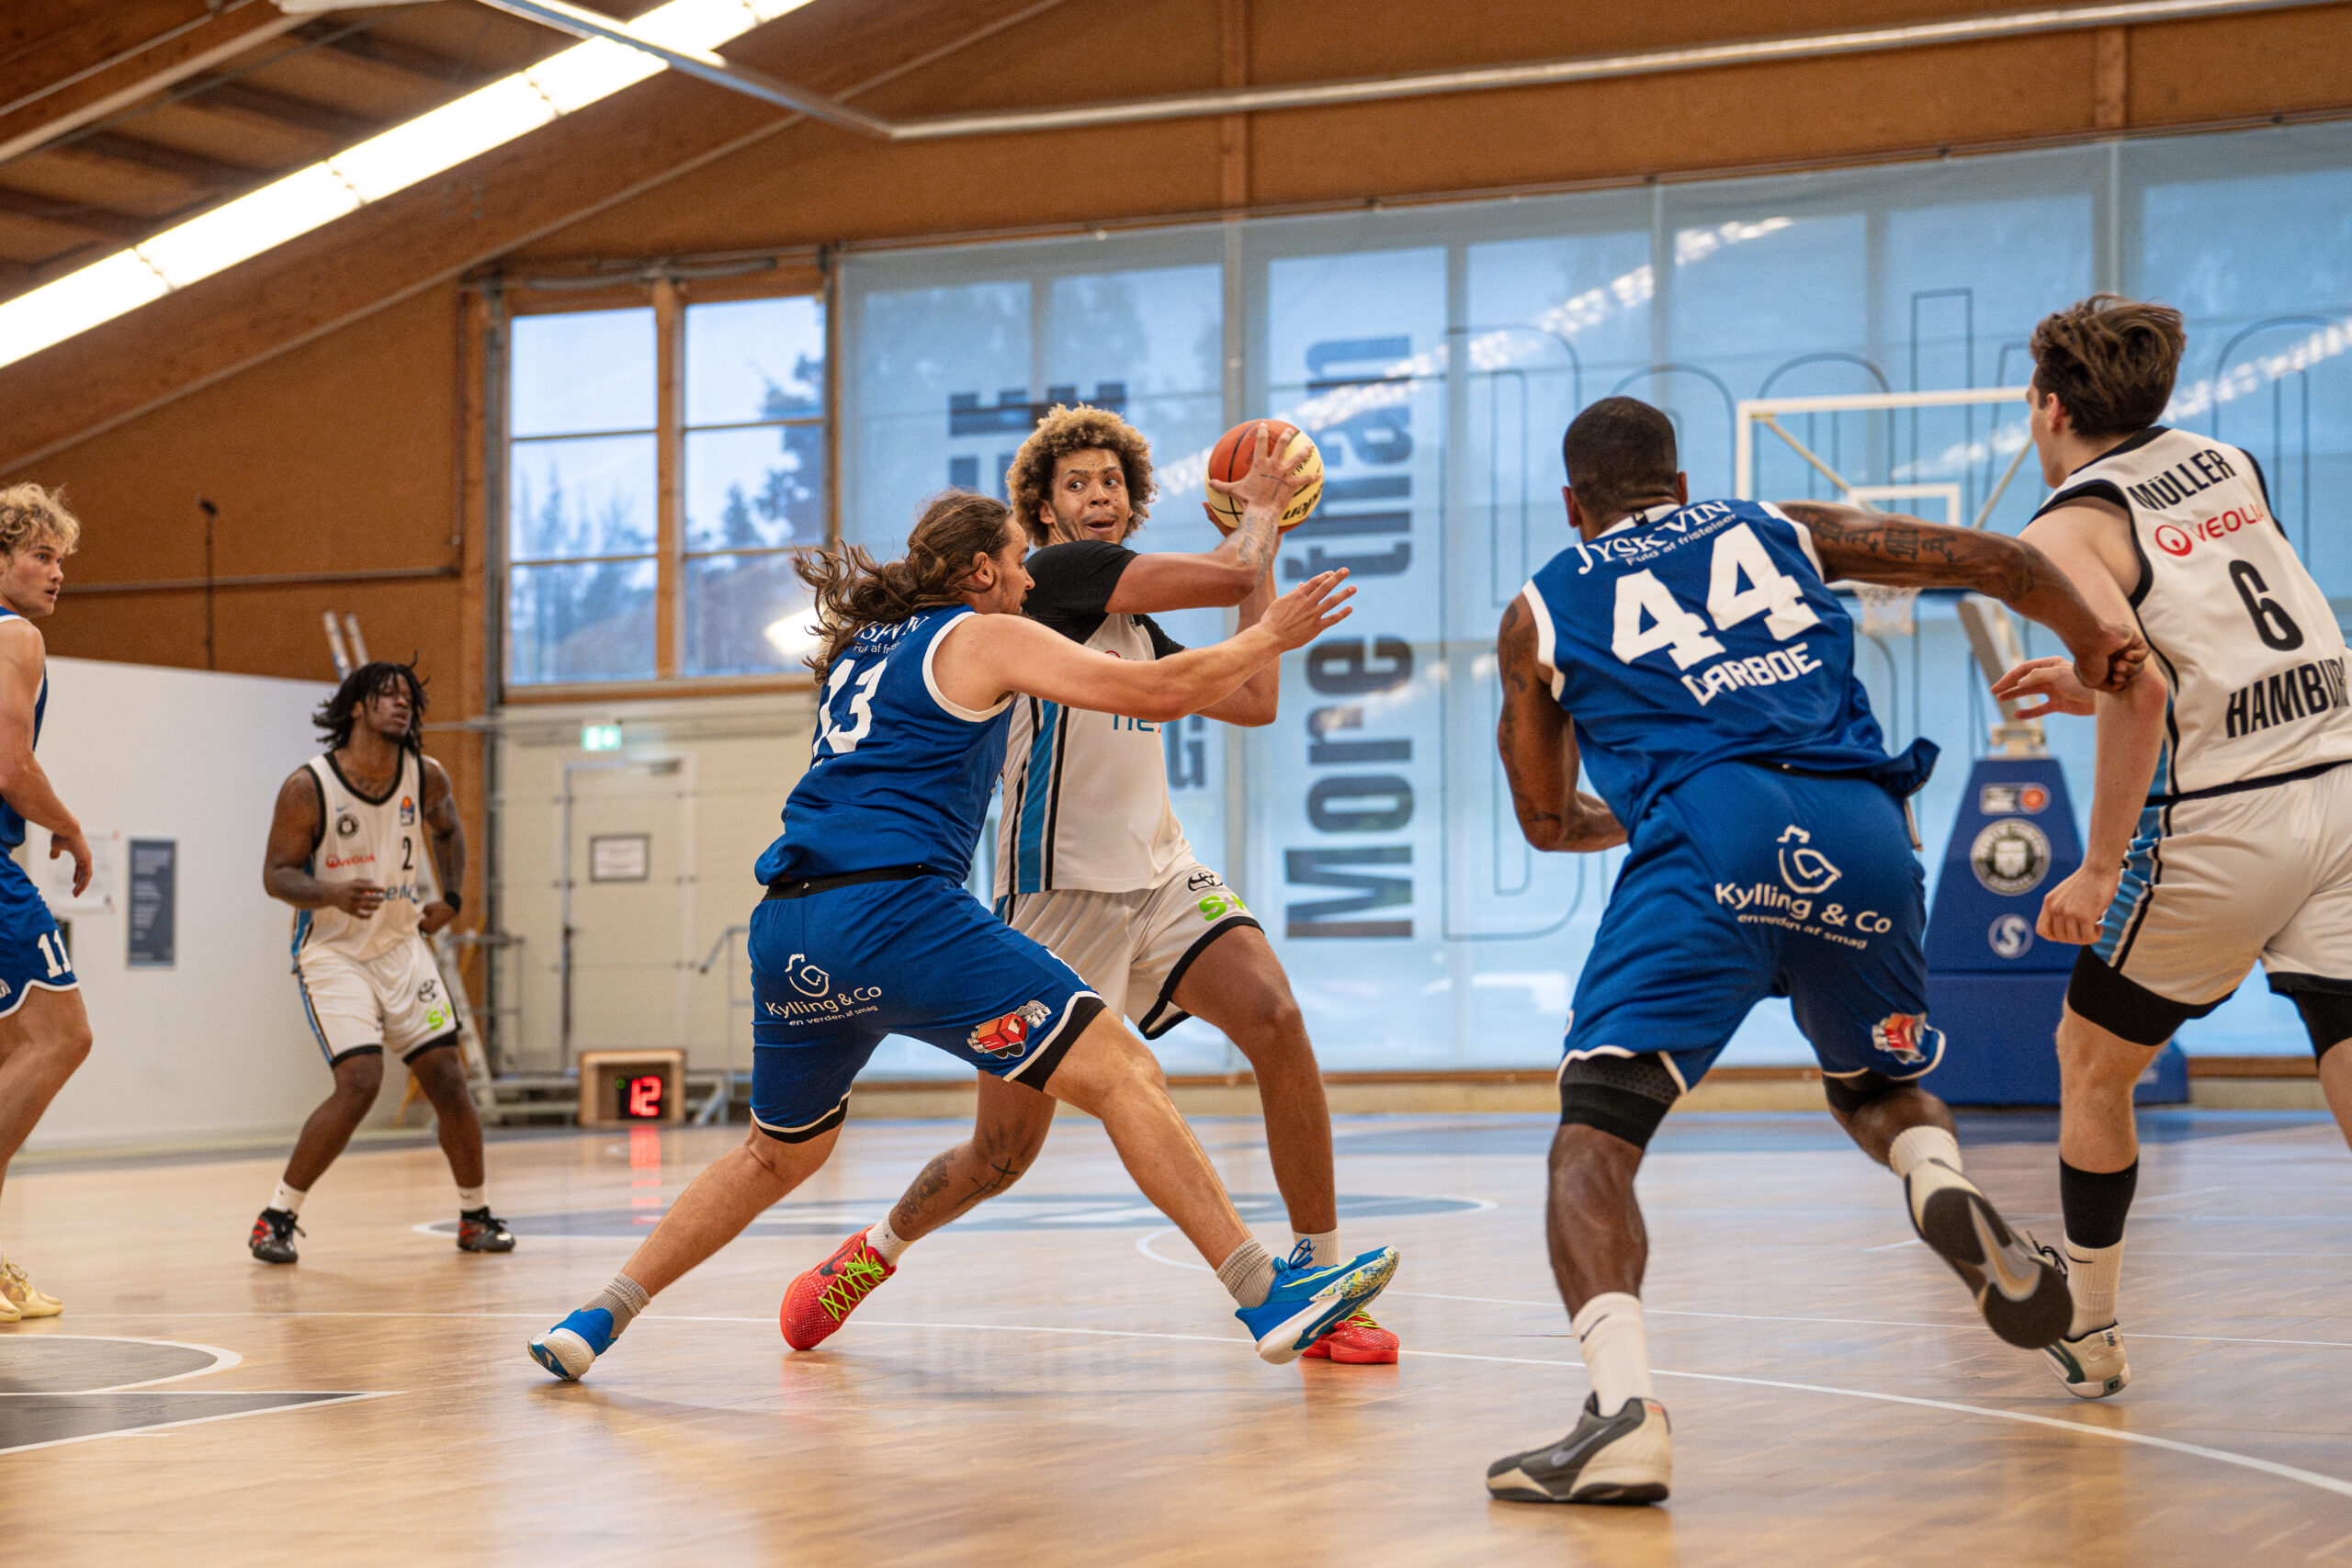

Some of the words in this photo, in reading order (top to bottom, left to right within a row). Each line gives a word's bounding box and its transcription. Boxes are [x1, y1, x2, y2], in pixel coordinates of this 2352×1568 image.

[1283, 335, 1412, 581] than
[2126, 448, 2236, 511] MÜLLER
[1575, 533, 1668, 575] JYSK
[1654, 501, 1733, 534] VIN
[1625, 549, 1659, 566] Fuld
[1611, 522, 1822, 671] 44
[2228, 559, 2304, 651] 6
[1680, 642, 1824, 706] DARBOE
[2225, 656, 2350, 739] HAMBUR
[812, 657, 888, 755] 13
[1284, 635, 1413, 939] More
[401, 837, 413, 871] 2
[1714, 882, 1813, 920] Kylling
[1820, 903, 1849, 928] &
[1854, 910, 1893, 934] Co
[38, 929, 72, 979] 11
[1823, 932, 1868, 951] smag
[765, 998, 840, 1019] Kylling
[837, 993, 855, 1006] &
[854, 986, 882, 1001] Co
[806, 1013, 846, 1024] verden
[854, 1004, 878, 1015] smag
[629, 1076, 662, 1117] 12
